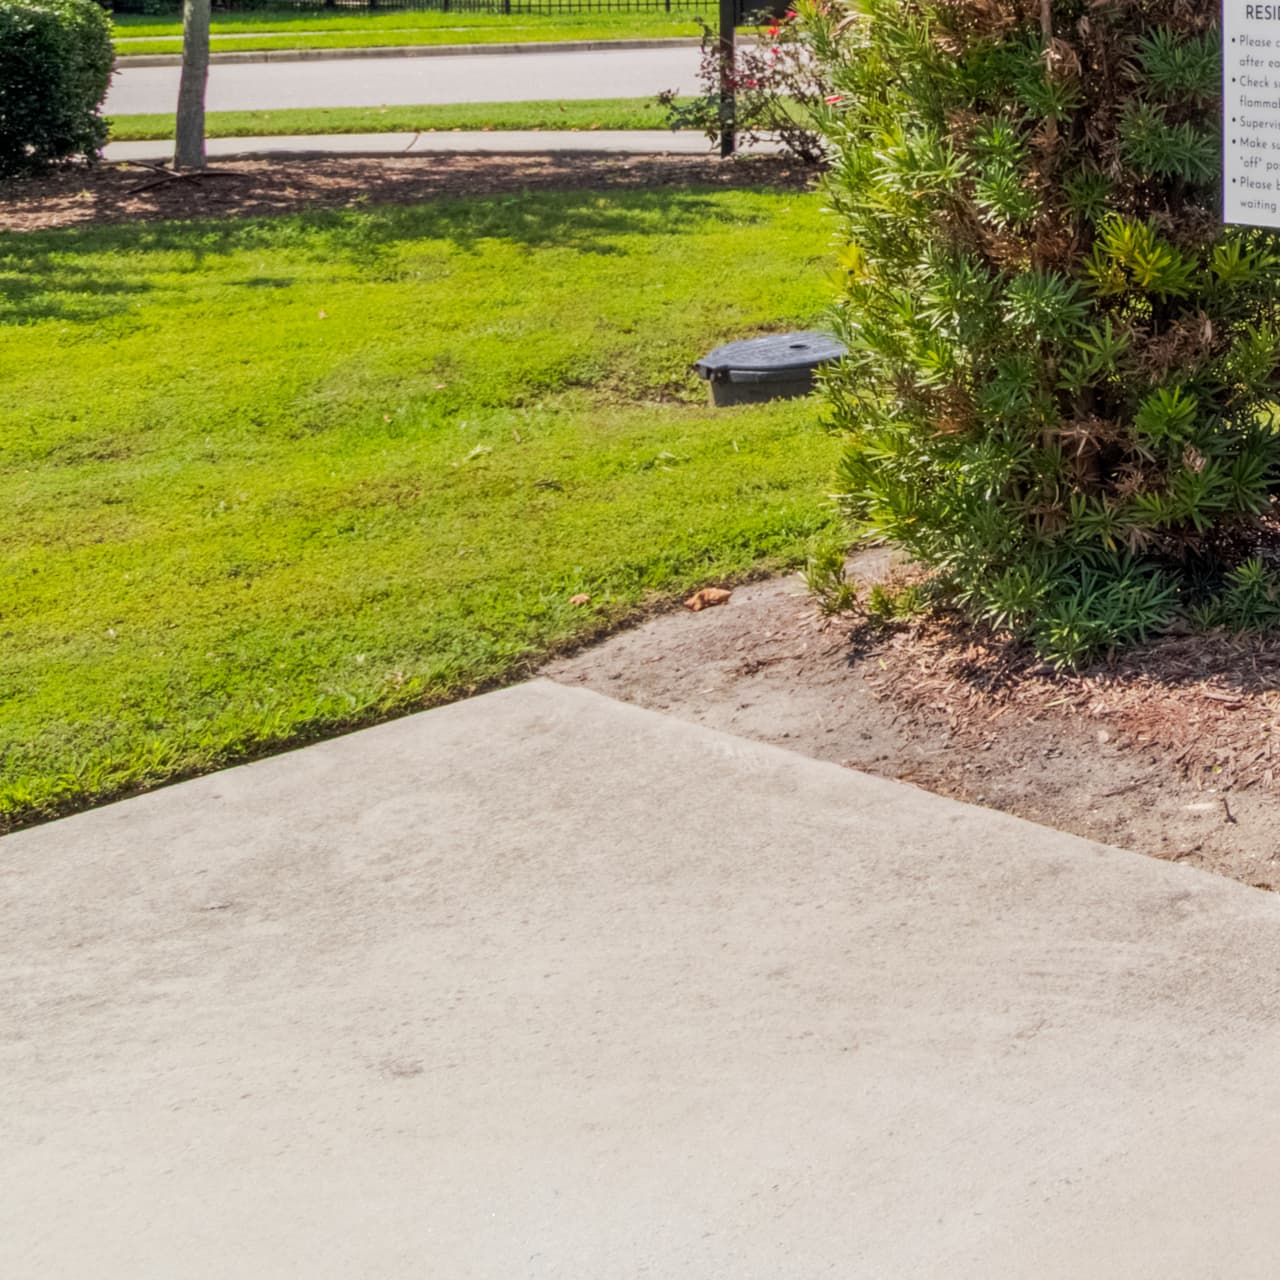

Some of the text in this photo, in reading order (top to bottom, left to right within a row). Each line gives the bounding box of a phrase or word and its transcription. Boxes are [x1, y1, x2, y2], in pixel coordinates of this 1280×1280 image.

[1239, 34, 1272, 47] Please
[1239, 54, 1265, 67] after
[1239, 75, 1269, 88] Check
[1239, 137, 1268, 150] Make
[1239, 176, 1273, 190] Please
[1240, 199, 1278, 214] waiting
